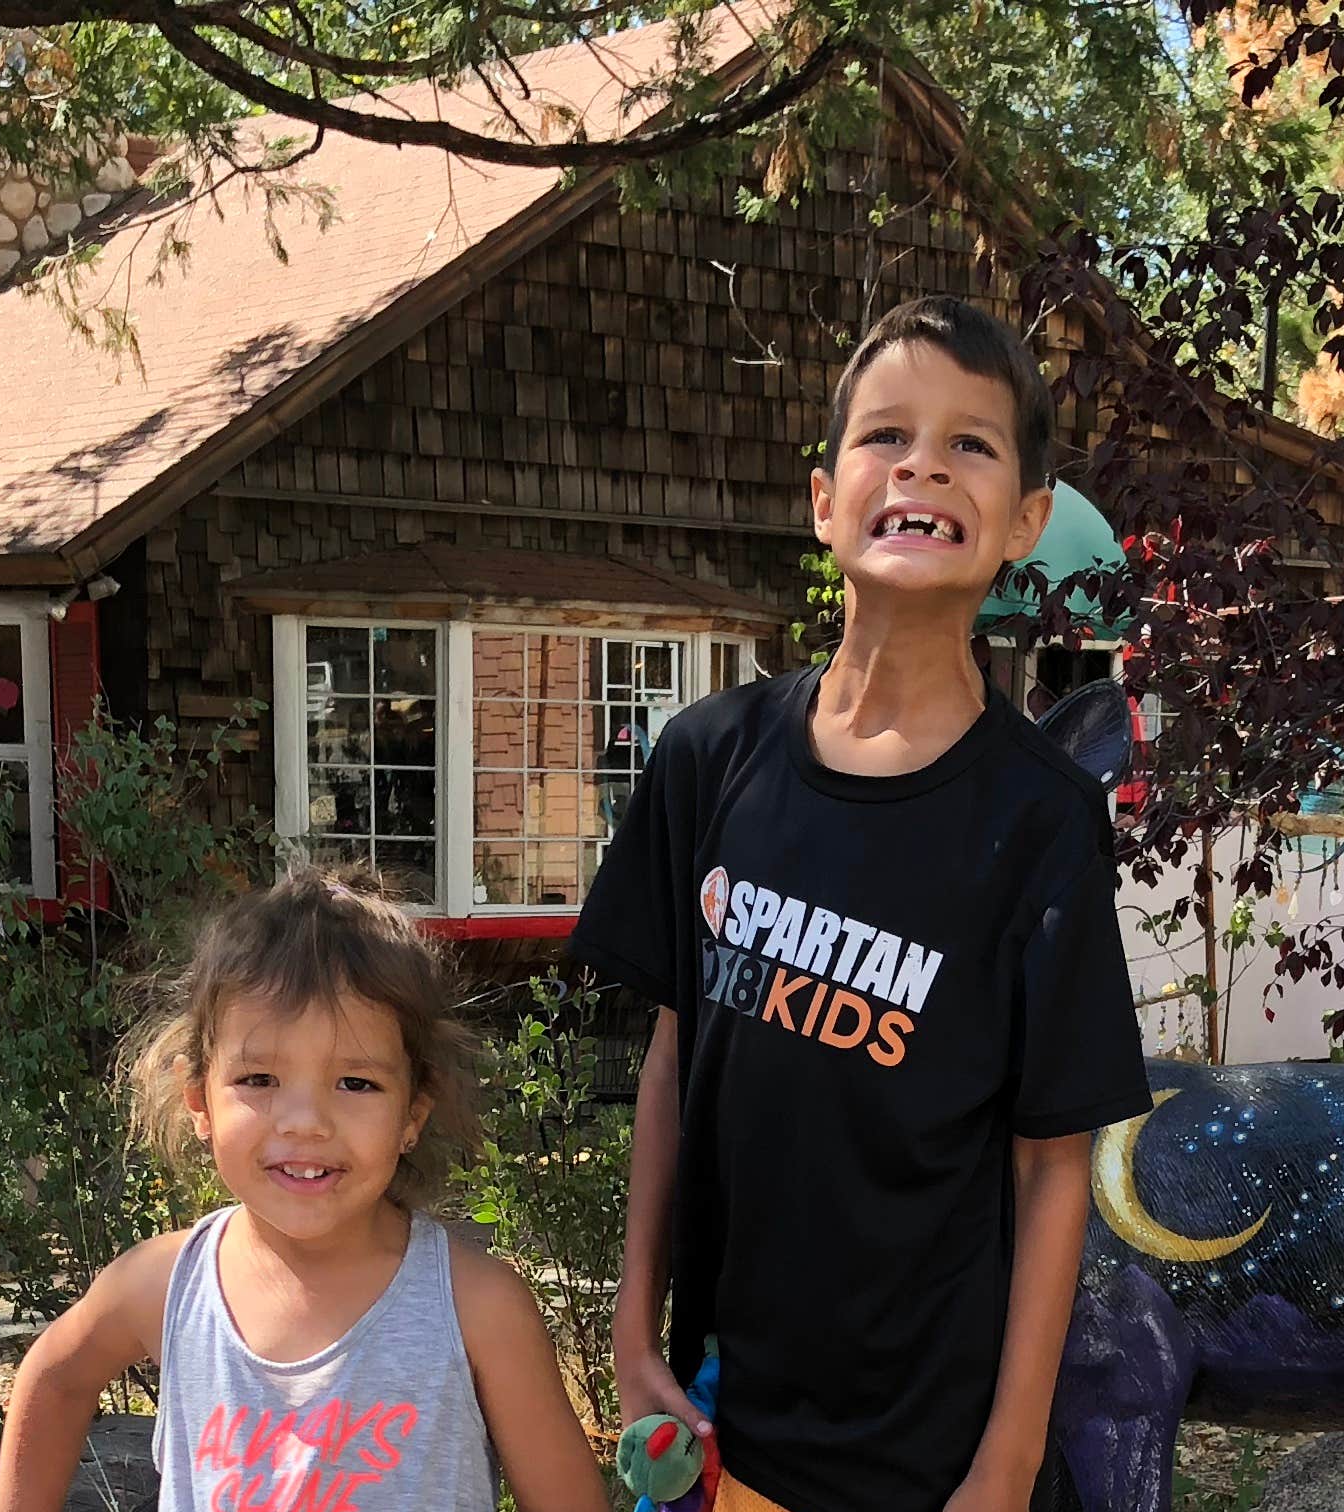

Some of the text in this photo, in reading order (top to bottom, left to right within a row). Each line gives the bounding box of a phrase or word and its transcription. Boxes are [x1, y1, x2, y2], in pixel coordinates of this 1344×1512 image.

[725, 881, 944, 1013] SPARTAN
[761, 967, 914, 1066] KIDS
[194, 1397, 418, 1472] ALWAYS
